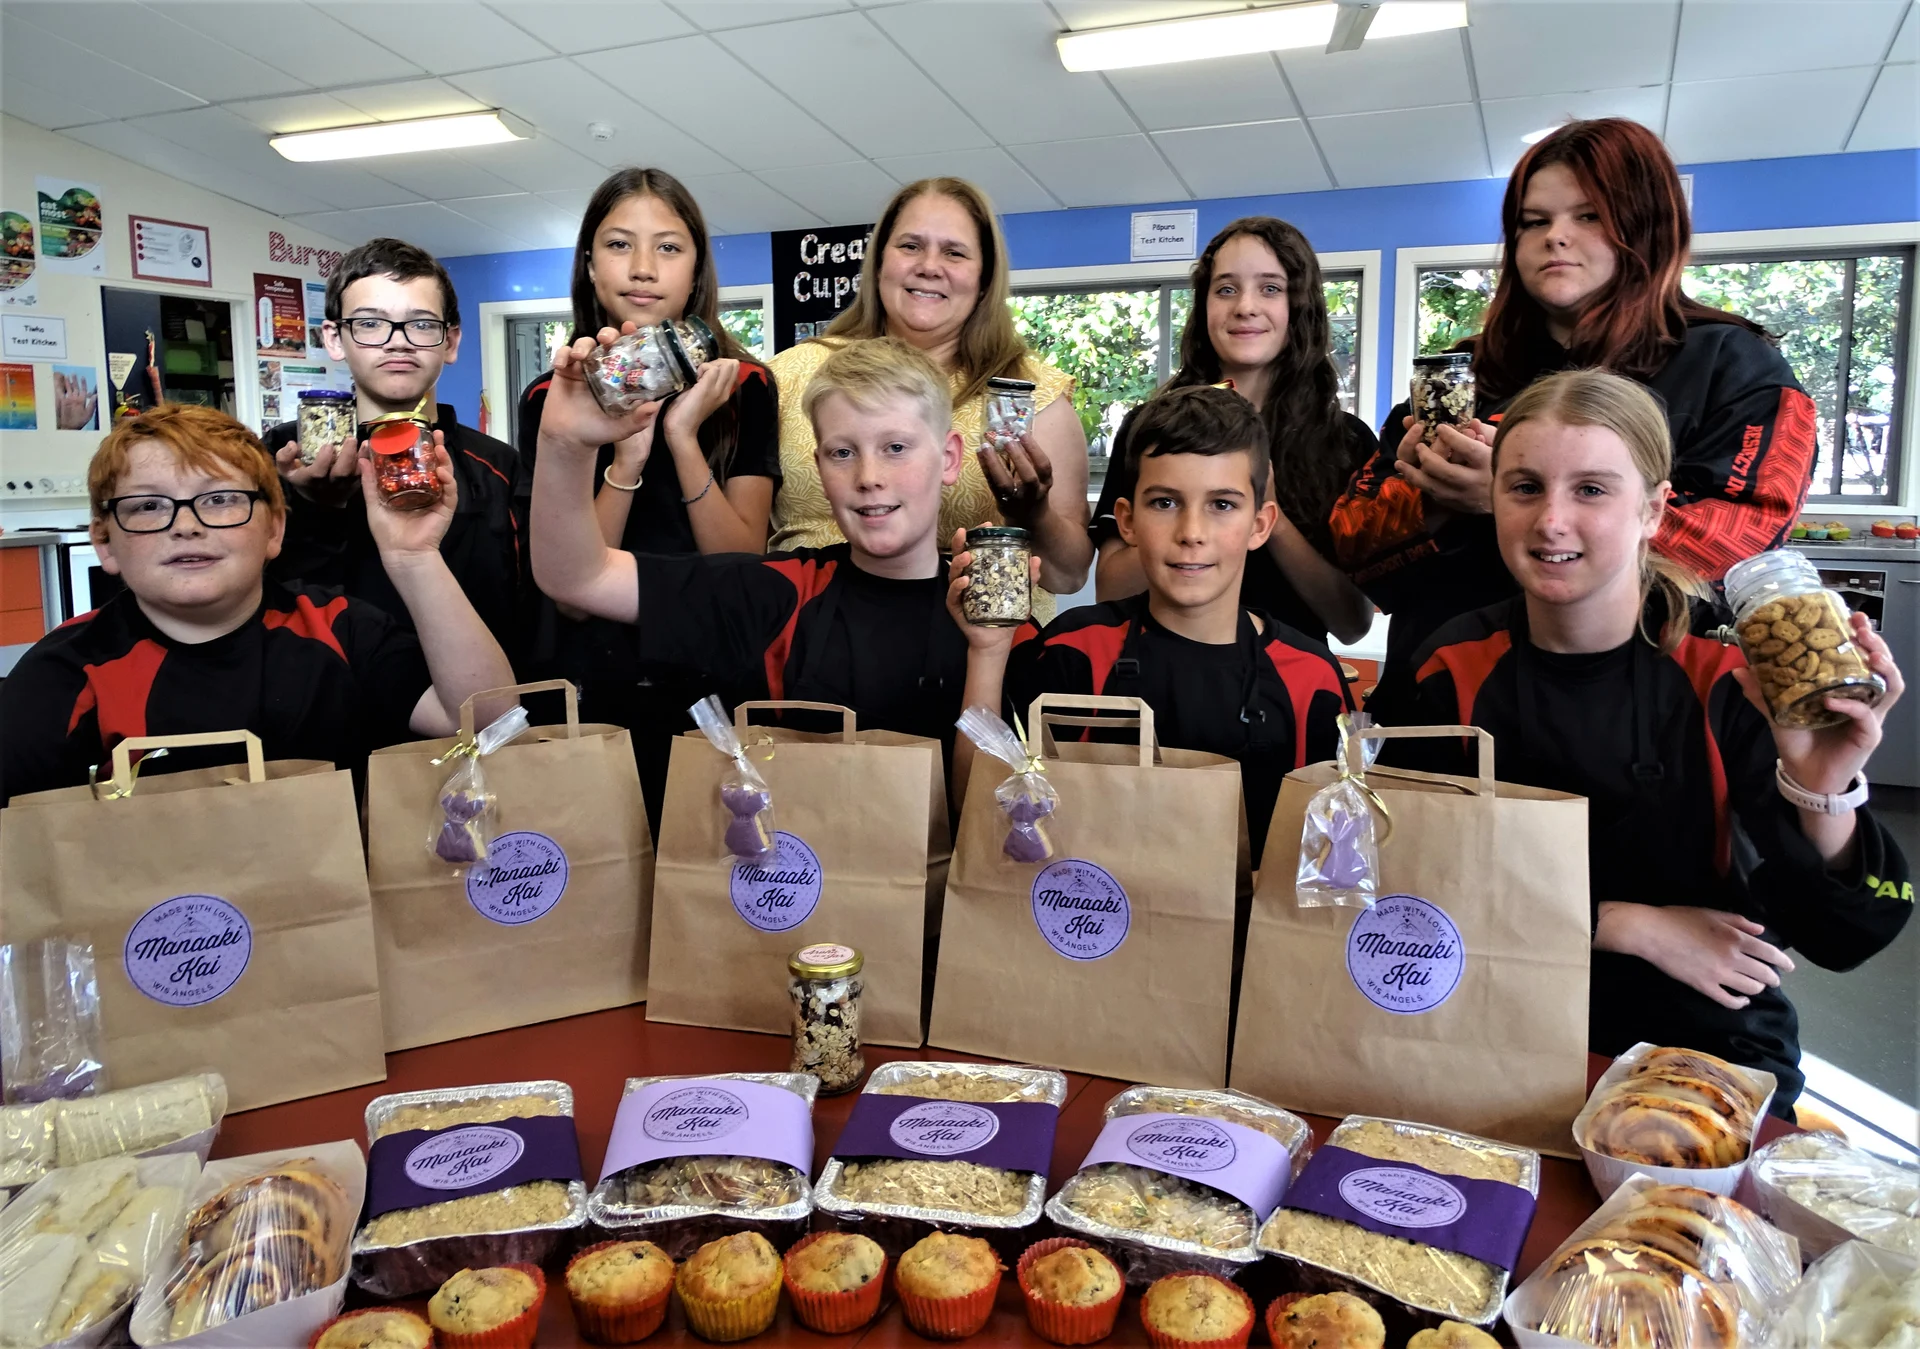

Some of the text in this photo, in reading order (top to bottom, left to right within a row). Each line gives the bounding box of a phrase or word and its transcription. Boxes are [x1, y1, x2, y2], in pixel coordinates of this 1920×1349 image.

[40, 202, 57, 210] eat
[40, 209, 67, 218] most
[1158, 236, 1184, 244] Kitchen
[269, 231, 344, 278] Burge
[32, 338, 58, 346] Kitchen
[492, 841, 512, 856] MADE
[538, 843, 554, 857] LOVE
[795, 848, 812, 866] LOVE
[738, 864, 816, 886] Manaaki
[1052, 868, 1114, 896] MADE WITH LOVE
[502, 881, 543, 906] Kai
[756, 888, 796, 912] Kai
[1039, 890, 1122, 913] Manaaki
[154, 904, 234, 925] MADE WITH LOVE
[504, 906, 538, 916] ANGELS
[756, 914, 788, 924] ANGELS
[1064, 914, 1104, 939] Kai
[1376, 904, 1448, 938] MADE WITH LOVE
[135, 925, 243, 962] Manaaki
[1065, 940, 1098, 951] ANGELS
[1357, 932, 1455, 959] Manaaki
[170, 955, 221, 985] Kai
[1382, 962, 1432, 991] Kai
[172, 984, 214, 996] ANGELS
[1383, 992, 1424, 1004] ANGELS
[652, 1105, 743, 1122] Manaaki
[676, 1116, 722, 1131] Kai
[898, 1117, 990, 1129] Manaaki
[919, 1128, 965, 1142] Kai
[1134, 1134, 1228, 1148] Manaaki
[412, 1138, 509, 1170] Manaaki
[1162, 1144, 1209, 1160] Kai
[448, 1153, 494, 1176] Kai
[452, 1169, 491, 1184] ANGELS
[1353, 1178, 1457, 1208] Manaaki
[1374, 1198, 1428, 1216] Kai
